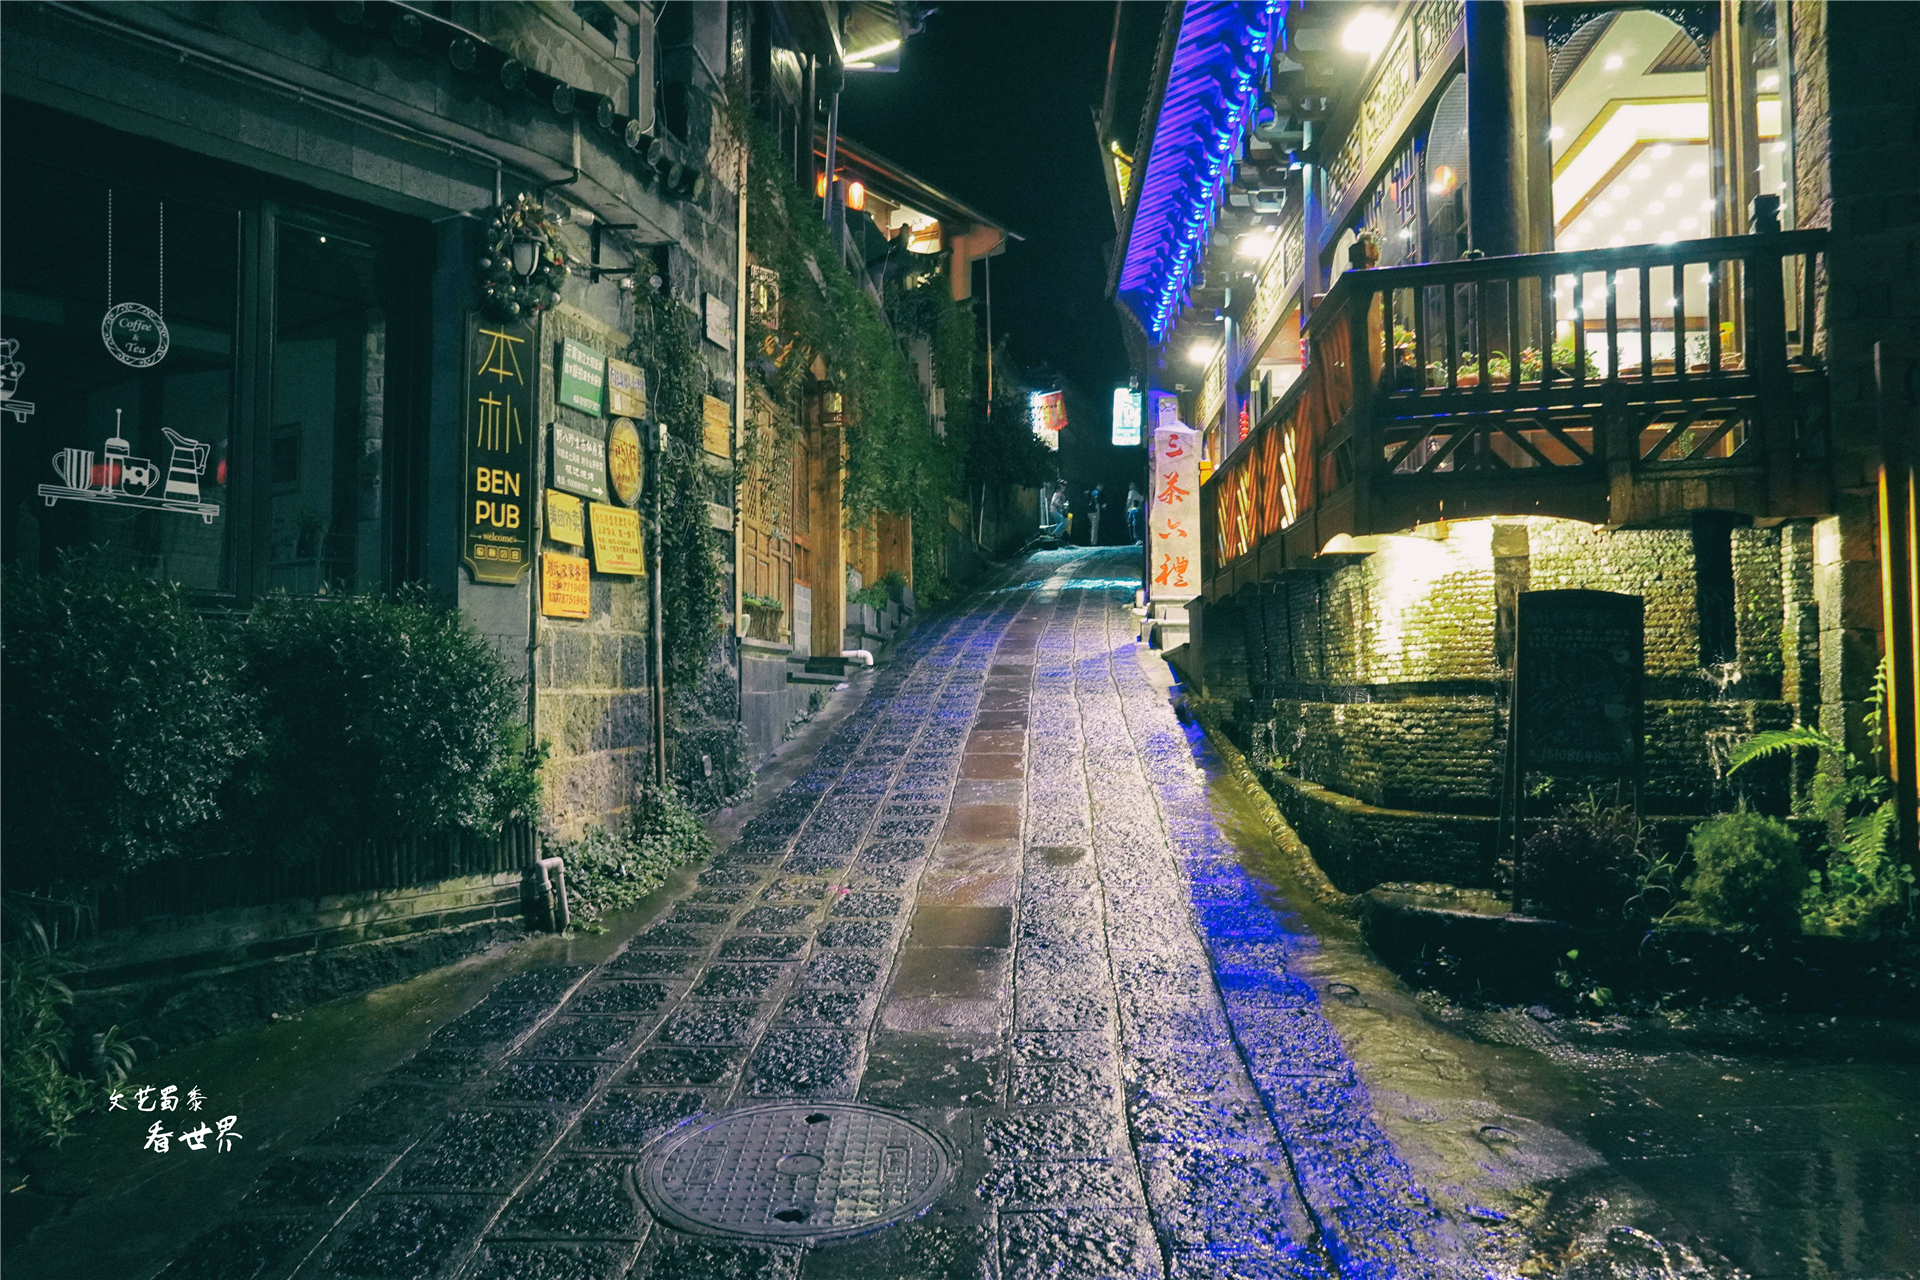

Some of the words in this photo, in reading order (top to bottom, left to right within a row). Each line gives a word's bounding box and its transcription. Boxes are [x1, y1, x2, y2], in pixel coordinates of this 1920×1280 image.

[119, 318, 152, 332] Coffee
[132, 333, 139, 341] &
[125, 342, 146, 354] Tea
[476, 466, 521, 496] BEN
[475, 500, 520, 529] PUB
[549, 503, 581, 532] 美团外卖
[483, 532, 514, 543] welcome
